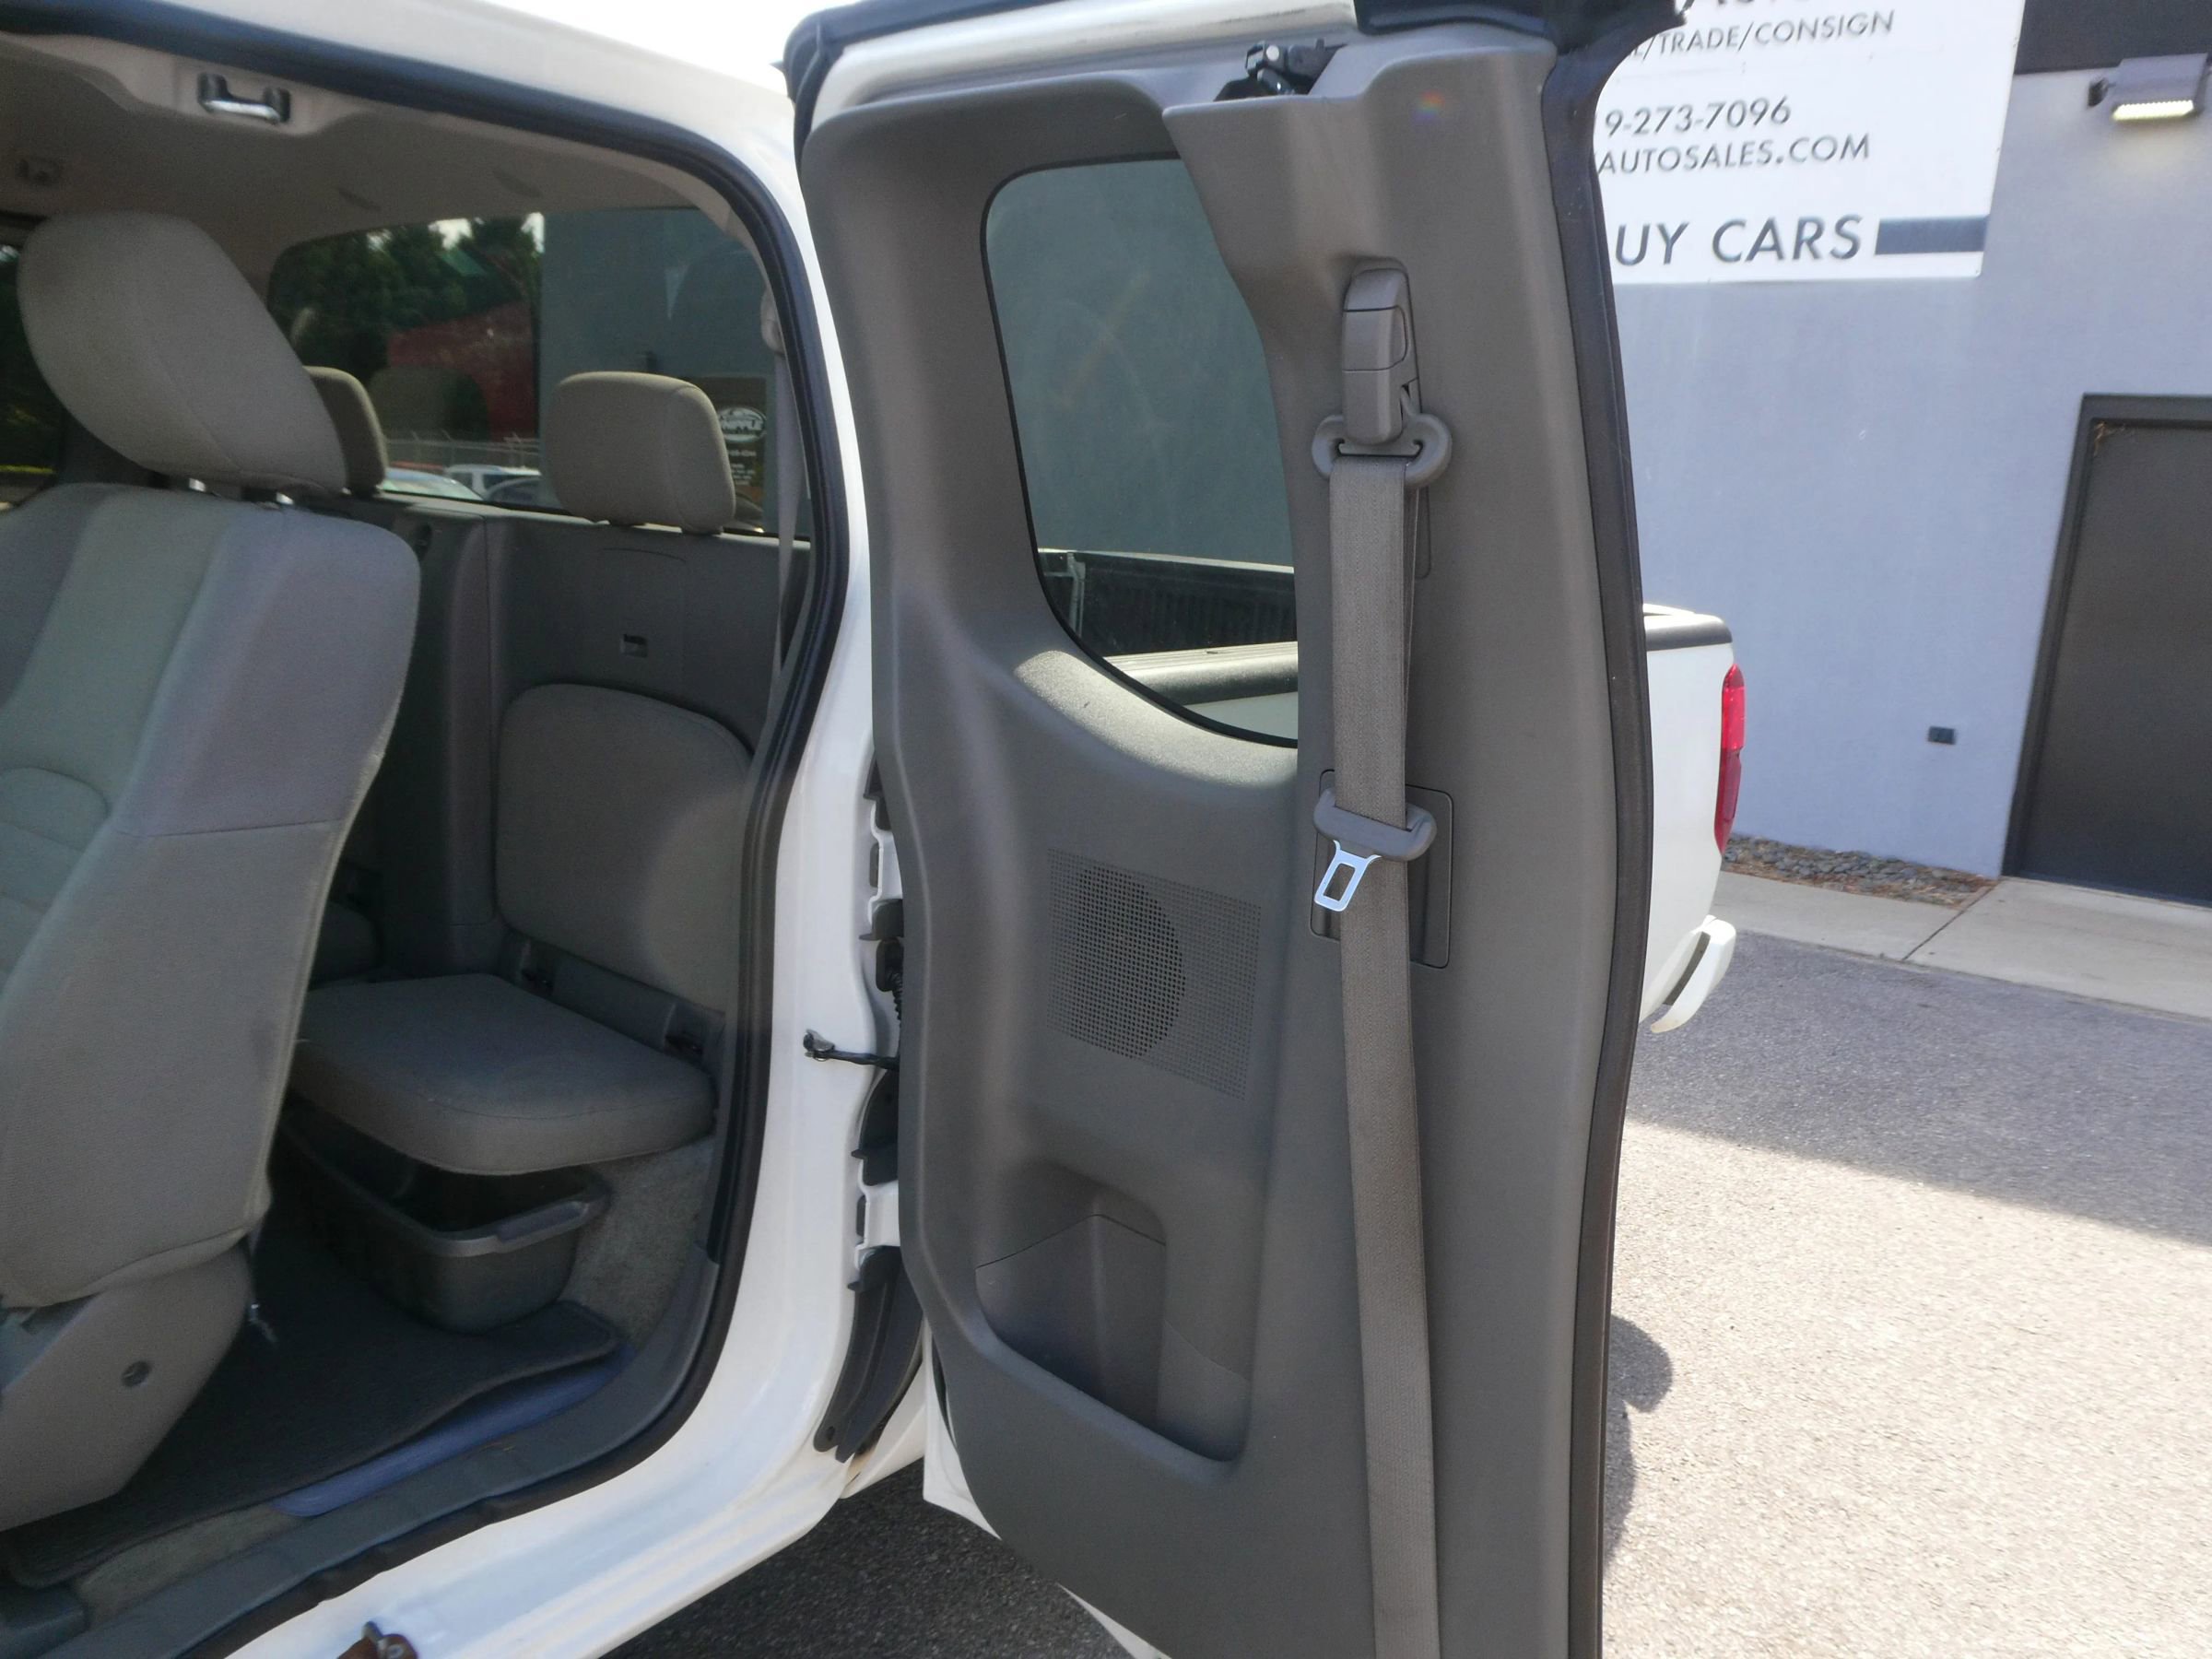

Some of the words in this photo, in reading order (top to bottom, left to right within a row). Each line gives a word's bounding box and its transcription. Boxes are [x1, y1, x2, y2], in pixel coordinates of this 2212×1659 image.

[1605, 96, 1792, 137] 9-273-7096
[1599, 133, 1870, 175] AUTOSALES.COM
[1615, 221, 1689, 266] UY
[1712, 214, 1864, 264] CARS
